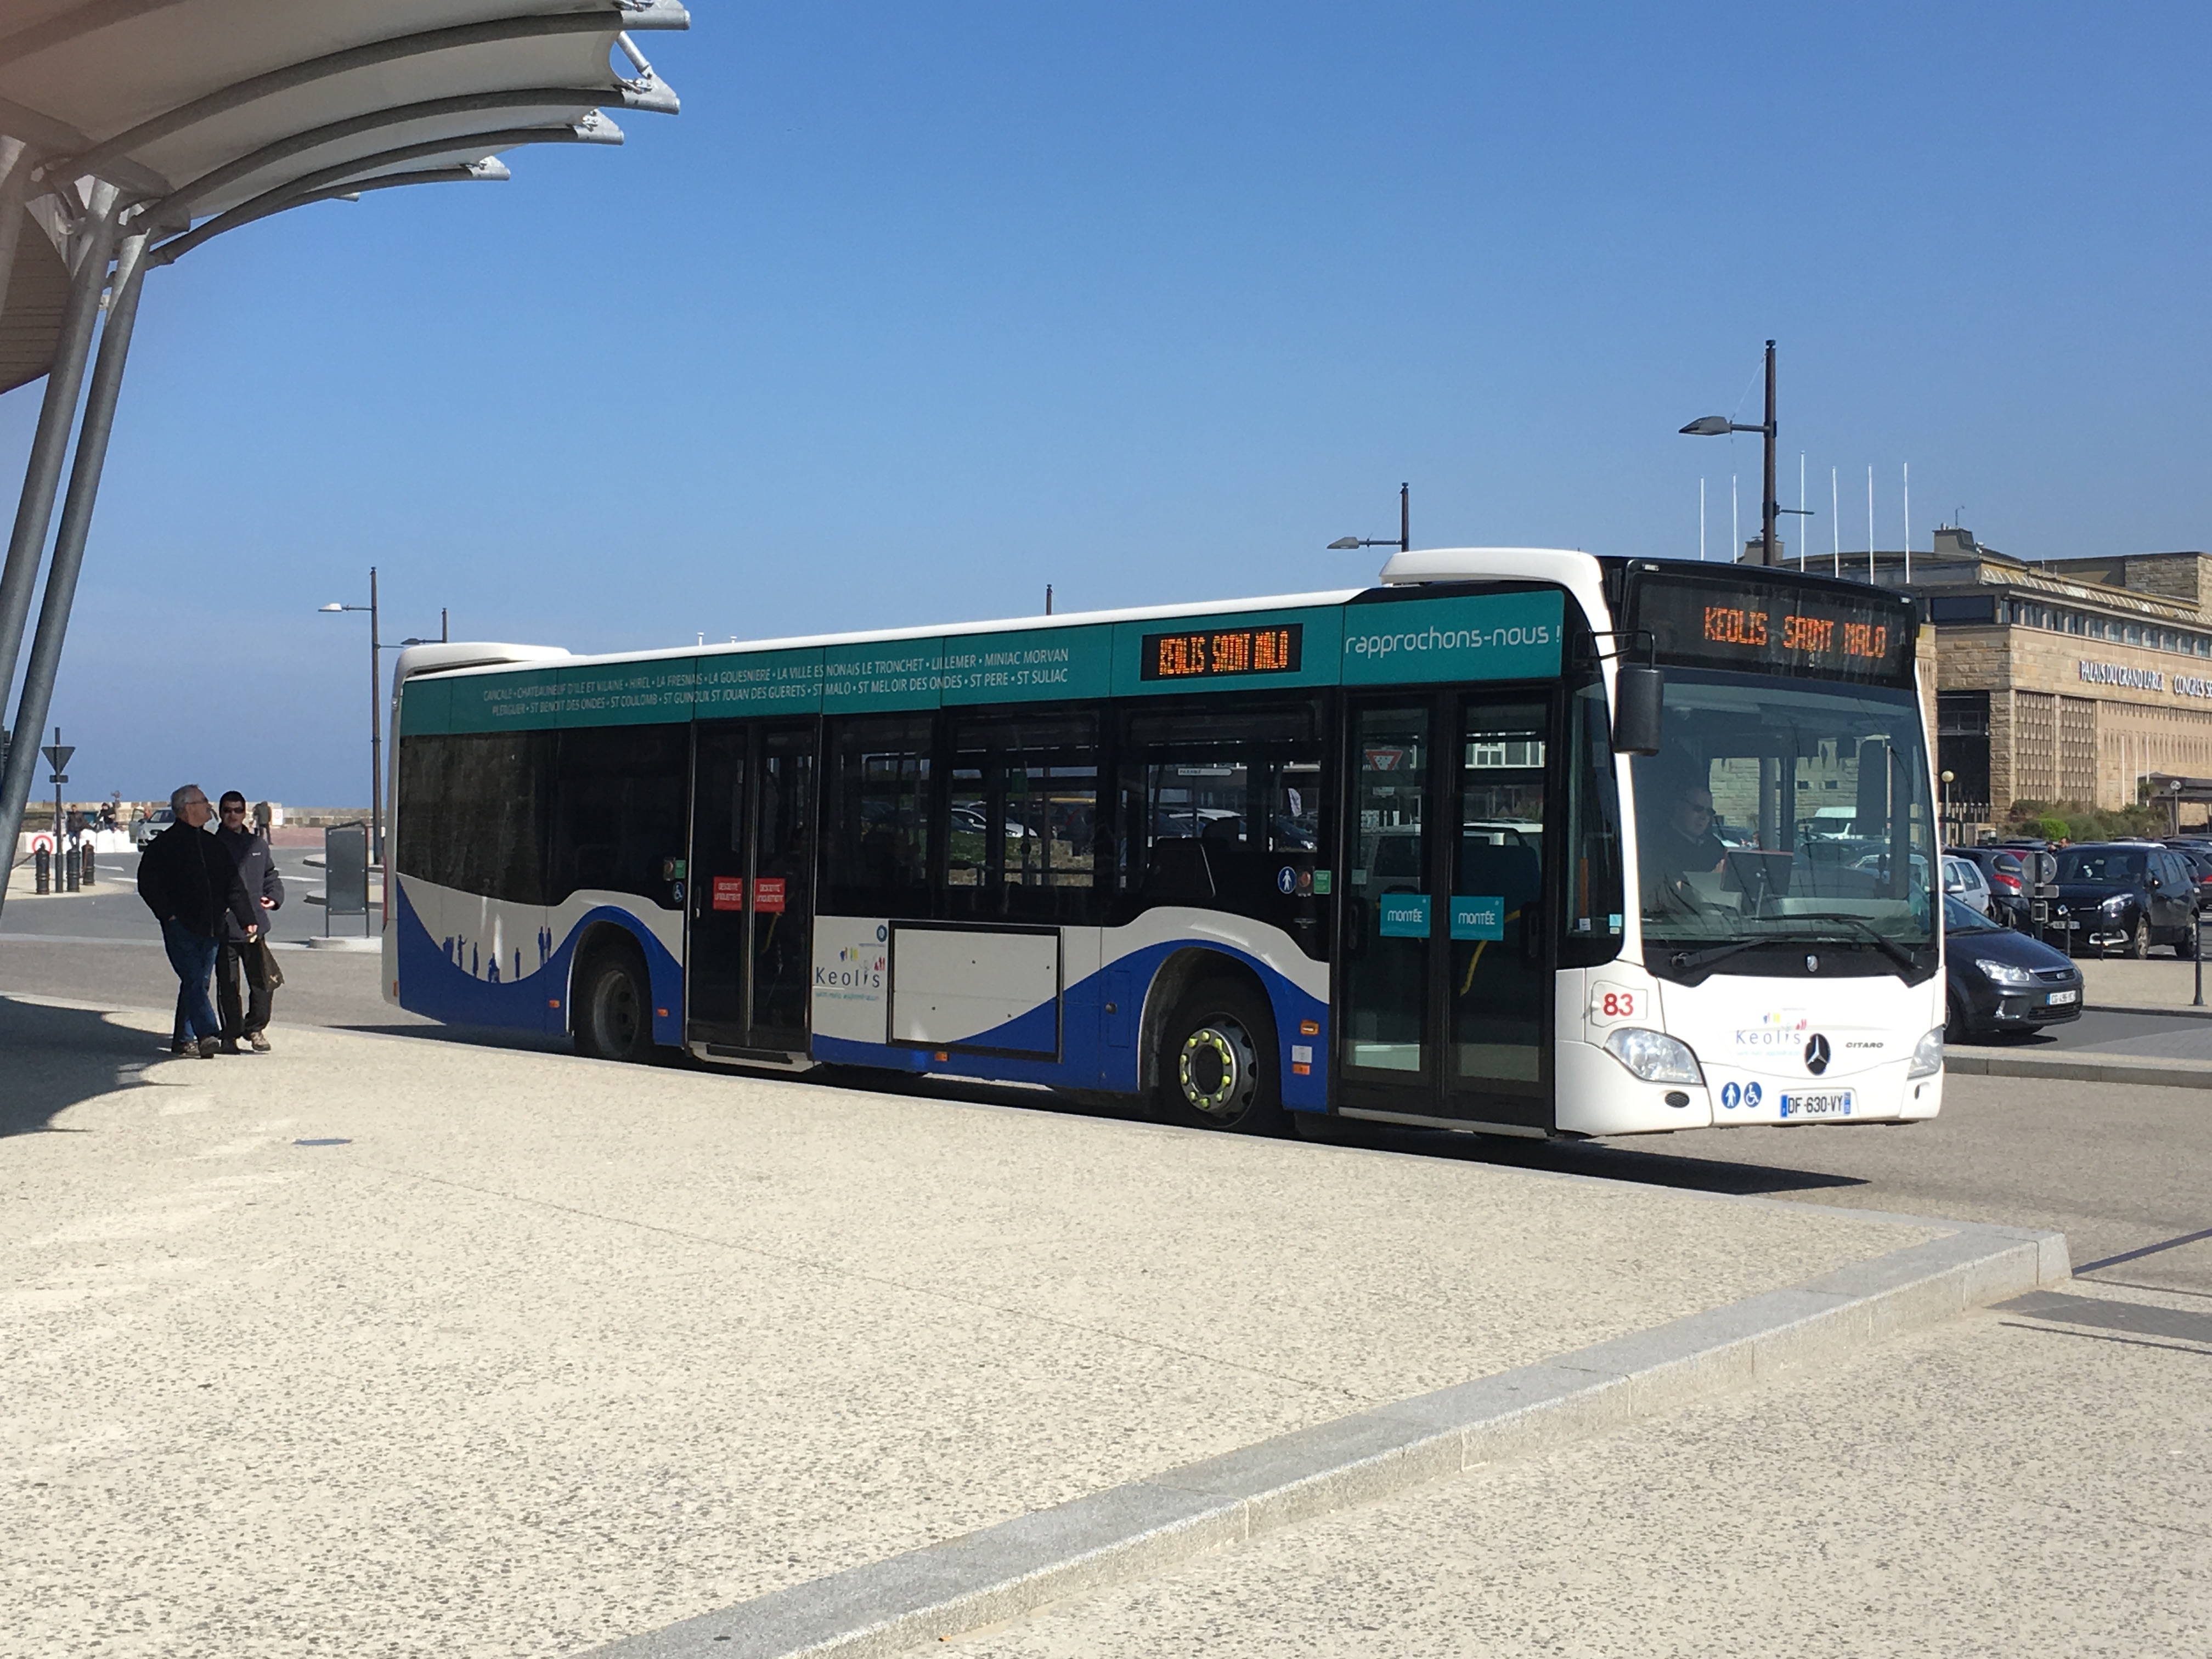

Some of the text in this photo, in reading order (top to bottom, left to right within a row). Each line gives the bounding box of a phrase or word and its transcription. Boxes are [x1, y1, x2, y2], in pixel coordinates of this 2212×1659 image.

[1345, 625, 1549, 658] rapprochons-nous
[1705, 607, 1886, 658] KEOLIS SAINT MALO
[657, 676, 665, 688] LA
[667, 673, 703, 686] FRESNAIS
[709, 672, 718, 684] LA
[720, 669, 770, 684] GOUESNIERE
[777, 668, 788, 680] LA
[789, 665, 811, 679] VILLE
[814, 664, 823, 678] ES
[826, 662, 860, 676] NONAIS
[862, 662, 872, 675] LE
[875, 658, 924, 674] TRONCHET
[932, 654, 977, 670] LILLEMER
[984, 651, 1020, 667] MINIAC
[1023, 648, 1069, 664] MORVAN
[2080, 661, 2165, 692] PALAIS DU GRAND LARGE
[530, 702, 539, 713] ST
[566, 699, 580, 712] DES
[580, 697, 605, 709] ONDES
[611, 696, 619, 708] ST
[621, 693, 658, 707] COULOMB
[663, 692, 673, 704] ST
[674, 690, 710, 704] GUINOUX
[711, 689, 721, 702] ST
[723, 687, 749, 701] JOUAN
[751, 686, 767, 699] DES
[769, 684, 806, 699] GUERETS
[813, 683, 822, 697] ST
[825, 681, 850, 695] MALO
[858, 681, 869, 694] ST
[871, 679, 907, 693] MELOIR
[910, 676, 927, 691] DES
[929, 675, 962, 690] ONDES
[970, 674, 982, 687] ST
[984, 672, 1008, 686] PERE
[1017, 670, 1029, 685] ST
[1031, 668, 1068, 685] SULIAC
[816, 967, 880, 988] Keolis
[1603, 993, 1634, 1017] 83
[1736, 1029, 1801, 1045] Keolis
